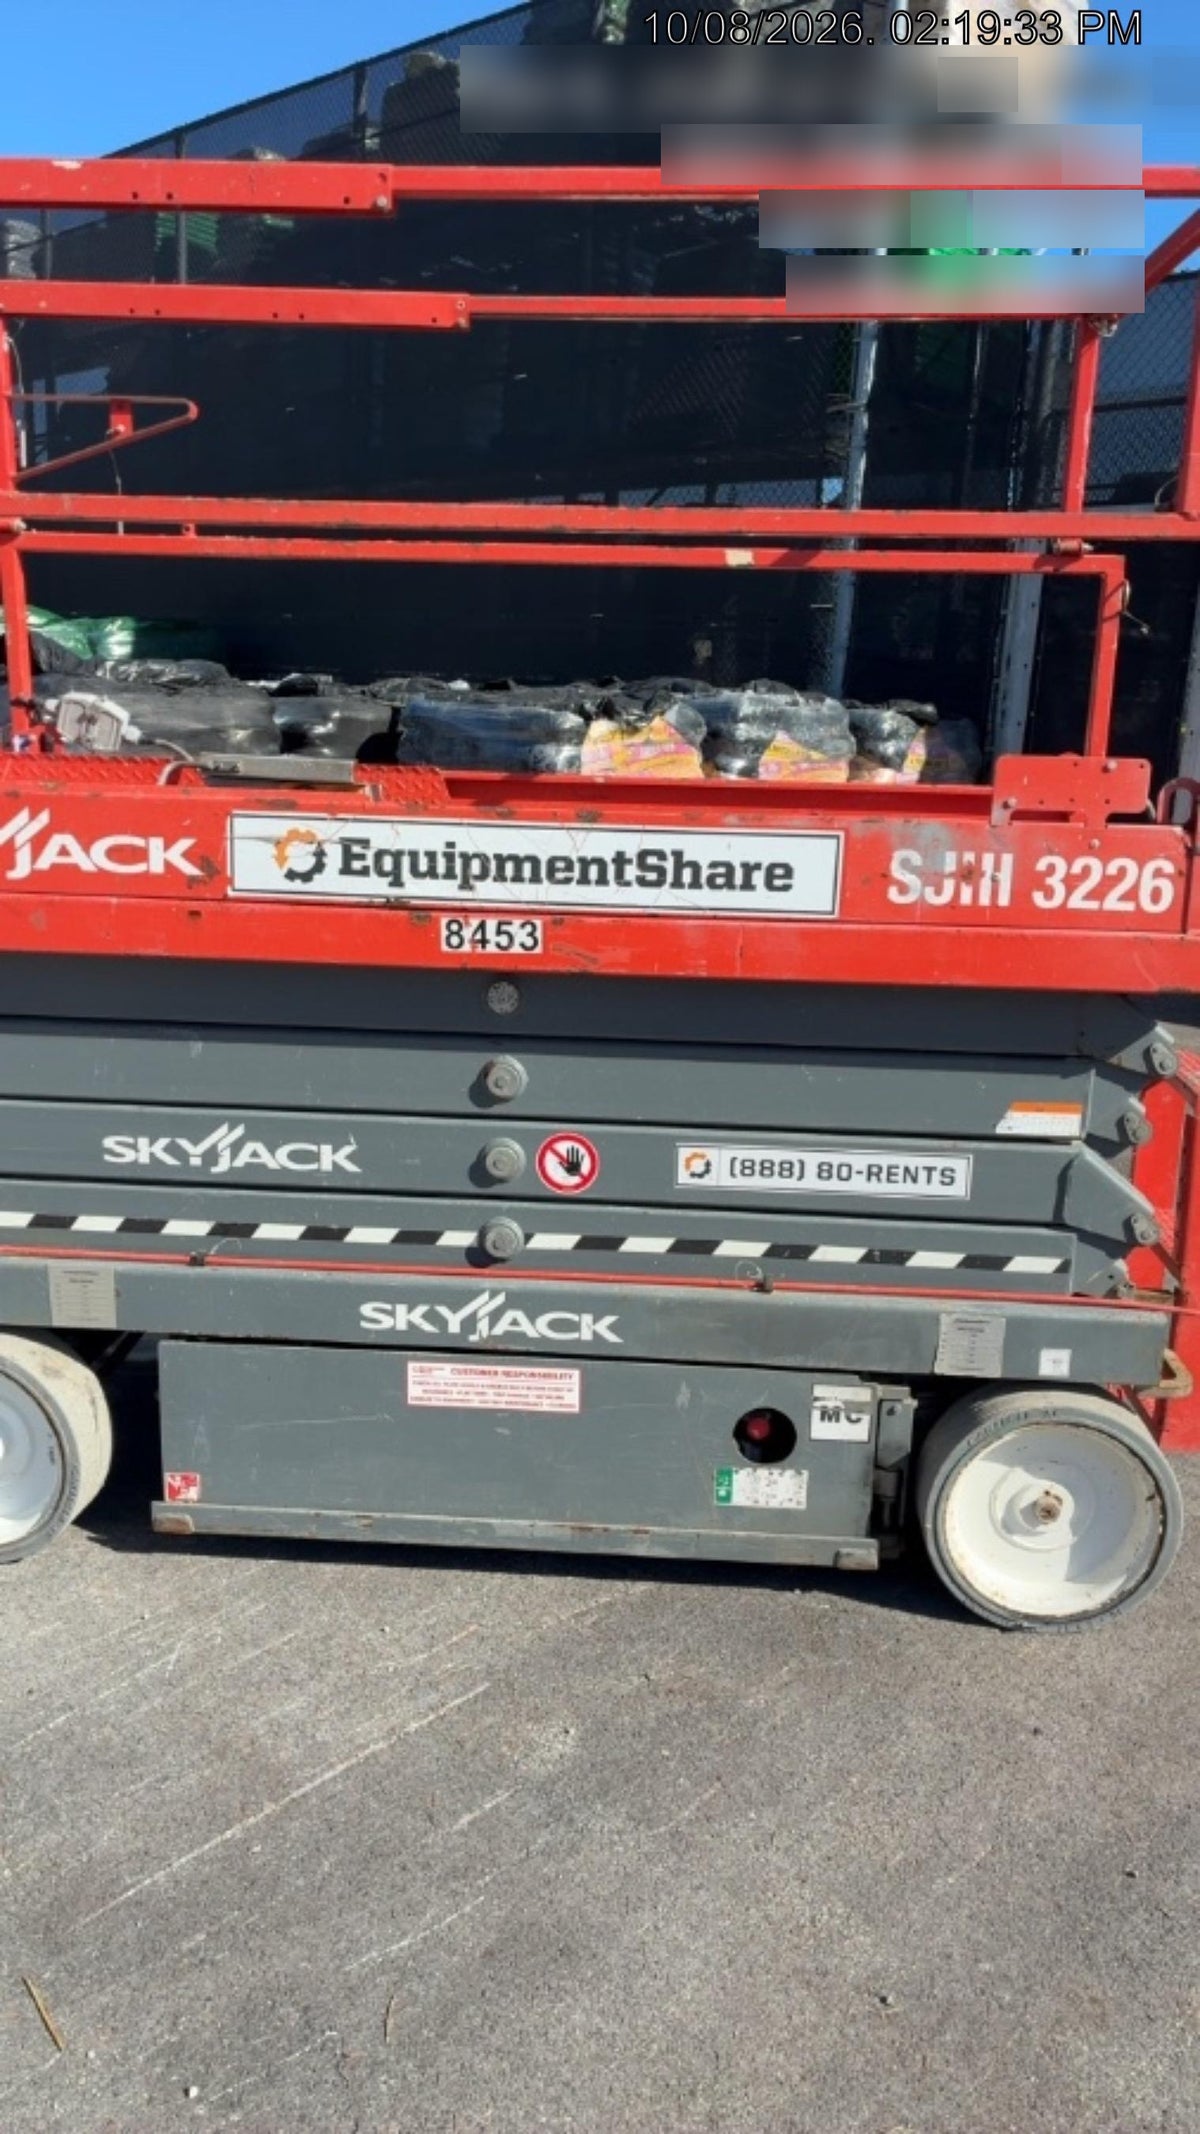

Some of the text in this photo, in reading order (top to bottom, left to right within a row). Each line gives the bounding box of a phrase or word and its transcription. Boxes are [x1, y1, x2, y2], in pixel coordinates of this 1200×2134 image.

[339, 837, 795, 893] EquipmentShare
[1031, 855, 1176, 914] 3226
[443, 919, 541, 952] 8453
[101, 1121, 363, 1174] SKYJACK
[729, 1156, 957, 1187] (888) 80-RENTS
[359, 1290, 624, 1343] SKYJACK
